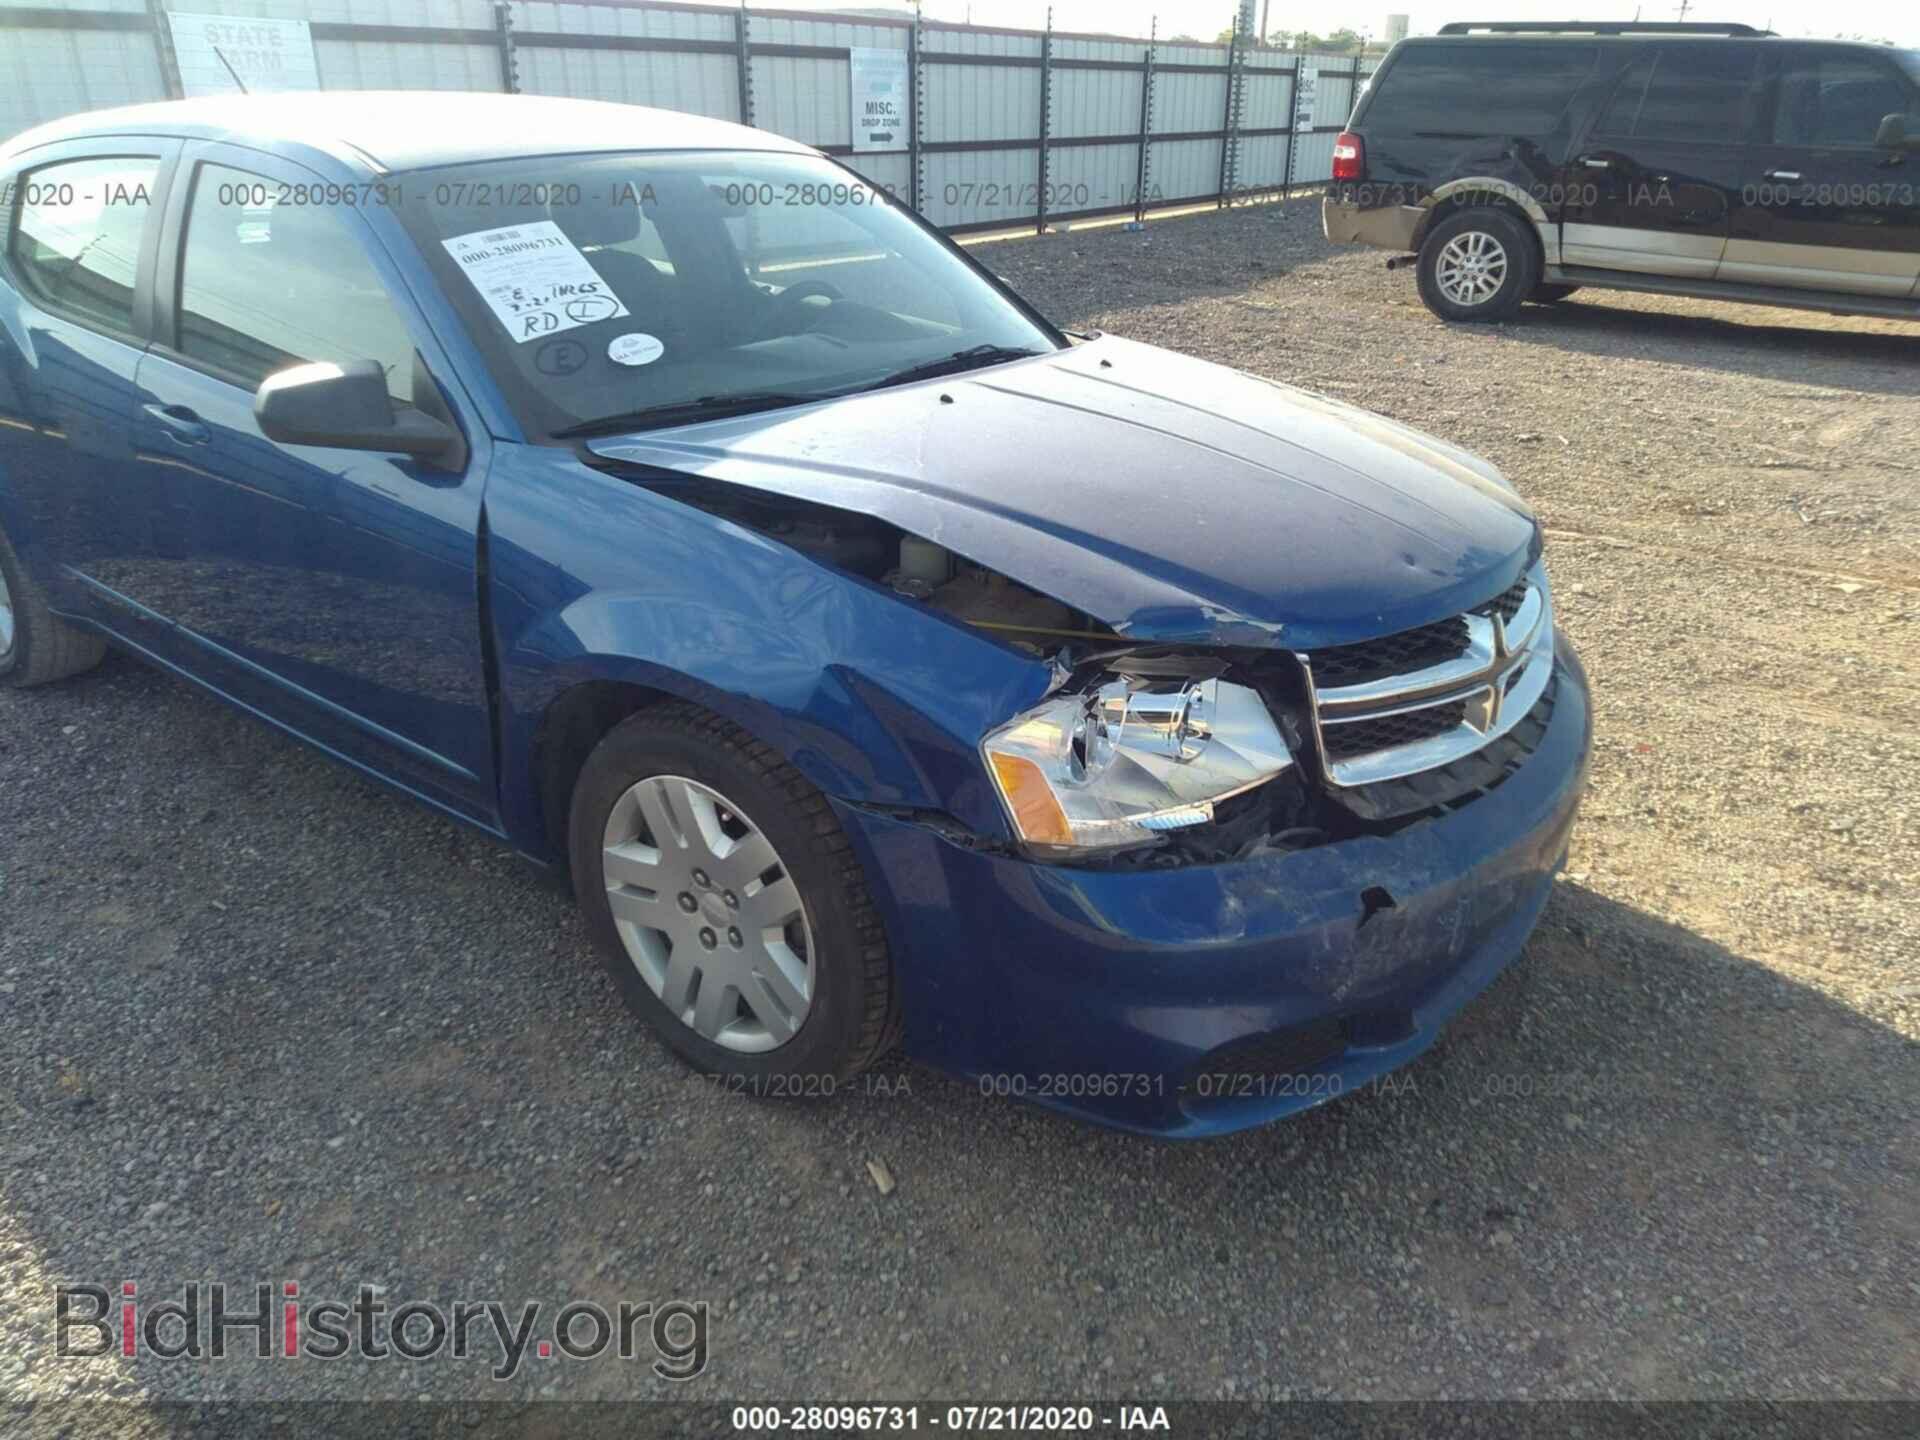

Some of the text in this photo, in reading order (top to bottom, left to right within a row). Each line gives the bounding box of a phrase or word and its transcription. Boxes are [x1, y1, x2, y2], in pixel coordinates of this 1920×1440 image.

[206, 23, 284, 46] STATE
[217, 48, 282, 71] ARM
[865, 101, 897, 115] MISC.
[861, 118, 901, 127] DROP ZONE
[462, 237, 564, 265] 000-28096731
